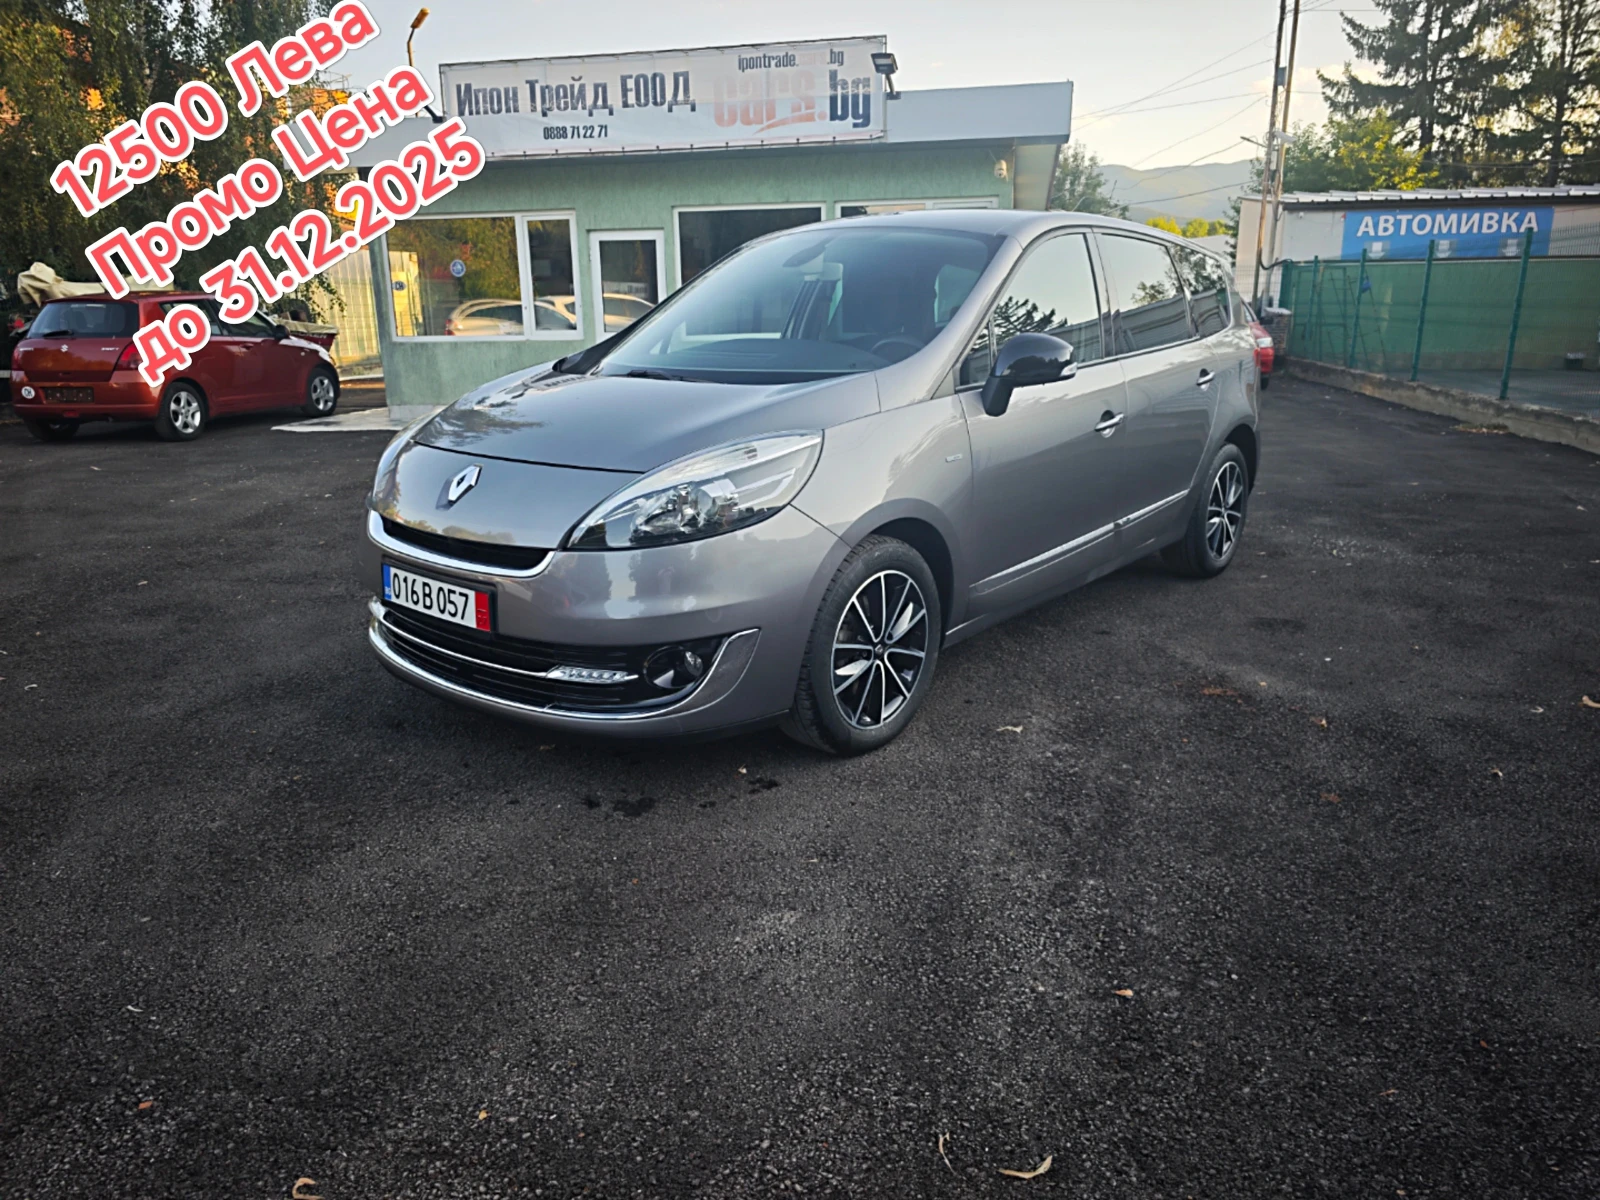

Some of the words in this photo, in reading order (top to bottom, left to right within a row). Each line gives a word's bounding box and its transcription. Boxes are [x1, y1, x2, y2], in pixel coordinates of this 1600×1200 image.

[456, 83, 519, 116] Ипон
[525, 76, 614, 117] Трейд
[620, 71, 696, 113] ЕООД
[543, 126, 568, 140] 0888
[570, 125, 581, 139] 71
[582, 125, 595, 139] 22
[597, 124, 608, 138] 71
[1356, 211, 1539, 237] АВТОМИВКА
